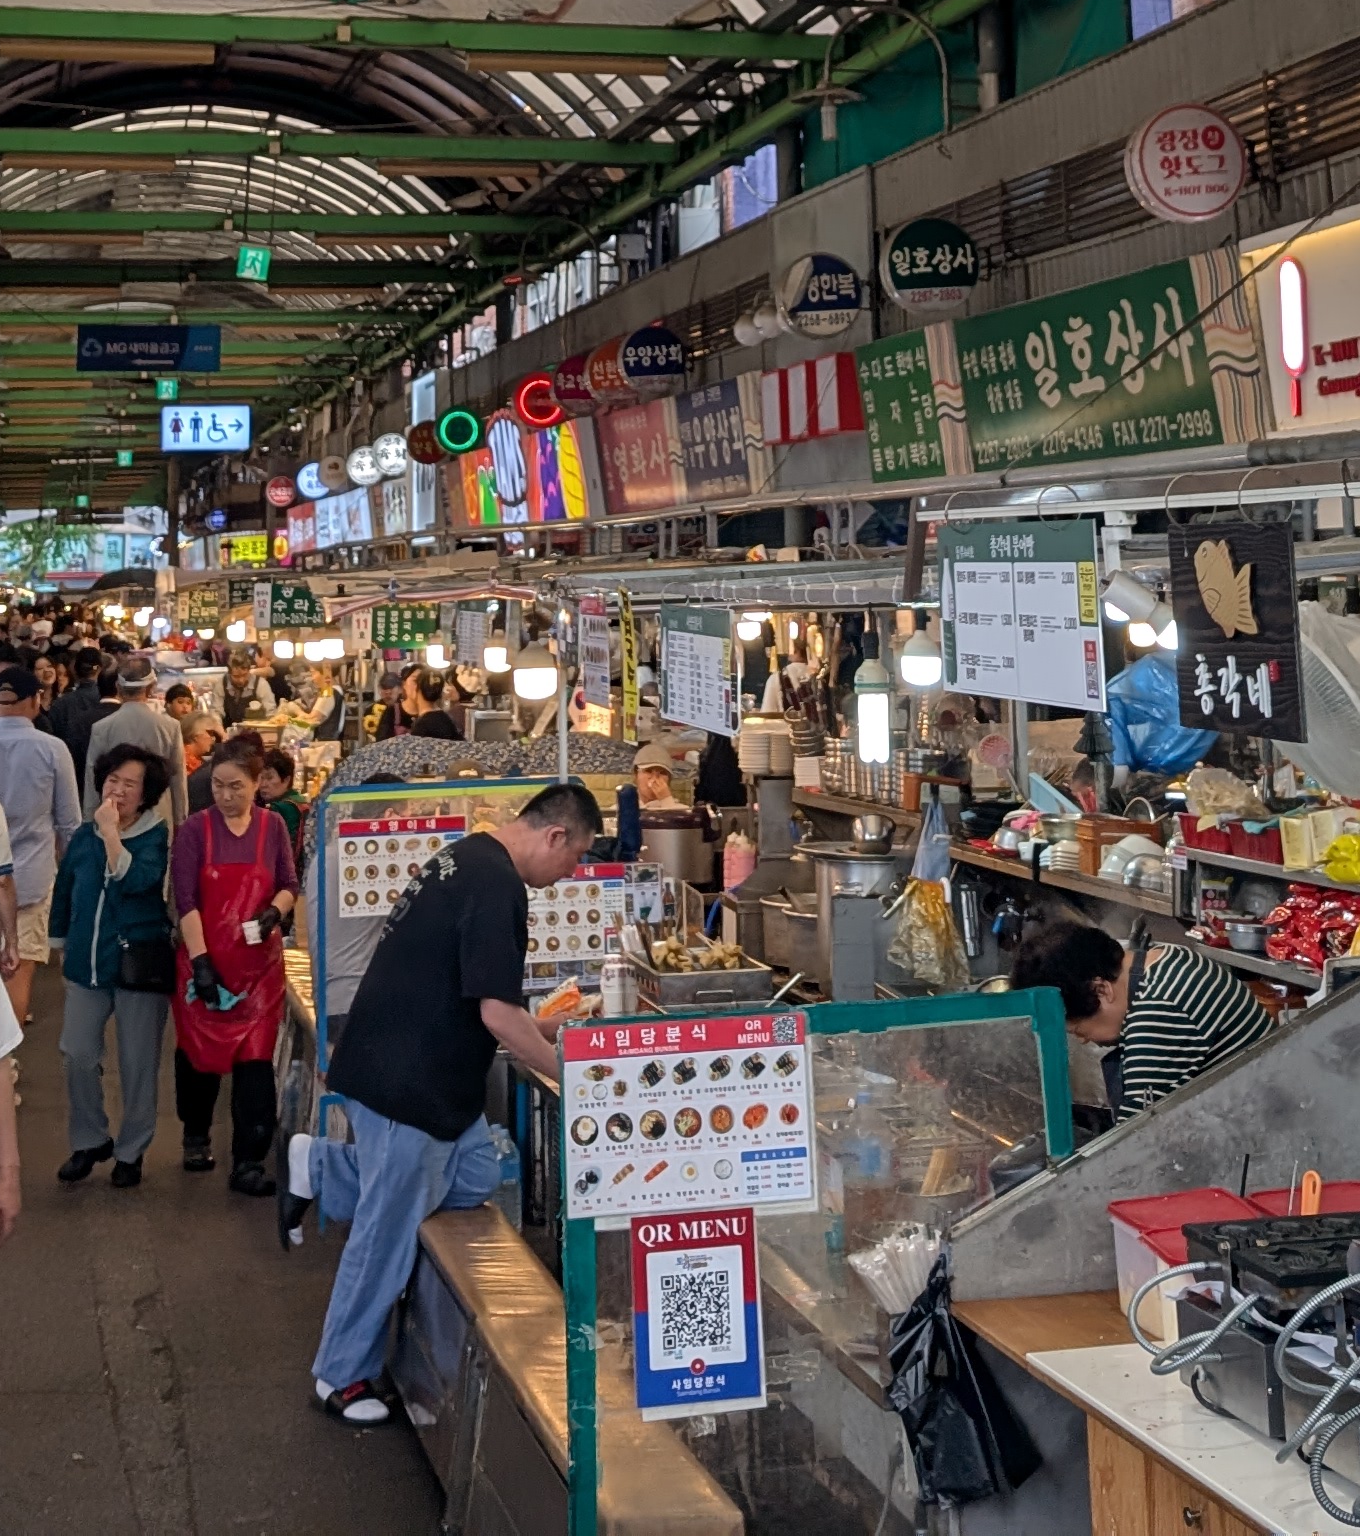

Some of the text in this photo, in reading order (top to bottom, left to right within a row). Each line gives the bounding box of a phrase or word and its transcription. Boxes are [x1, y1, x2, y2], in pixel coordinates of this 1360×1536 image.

[1155, 128, 1198, 153] 광장
[1160, 154, 1228, 179] 핫도그
[891, 243, 975, 276] 일호상사
[1024, 286, 1196, 408] 일호상사
[1113, 420, 1138, 447] FAX
[1139, 409, 1214, 445] 2271-2998
[990, 534, 1011, 558] 총각네
[355, 618, 369, 630] 11
[1192, 652, 1275, 720] 총각네
[589, 1020, 762, 1049] 사임당분식 QR
[737, 1031, 770, 1045] MENU
[638, 1216, 747, 1248] QR MENU
[672, 1374, 726, 1391] 사임당분식
